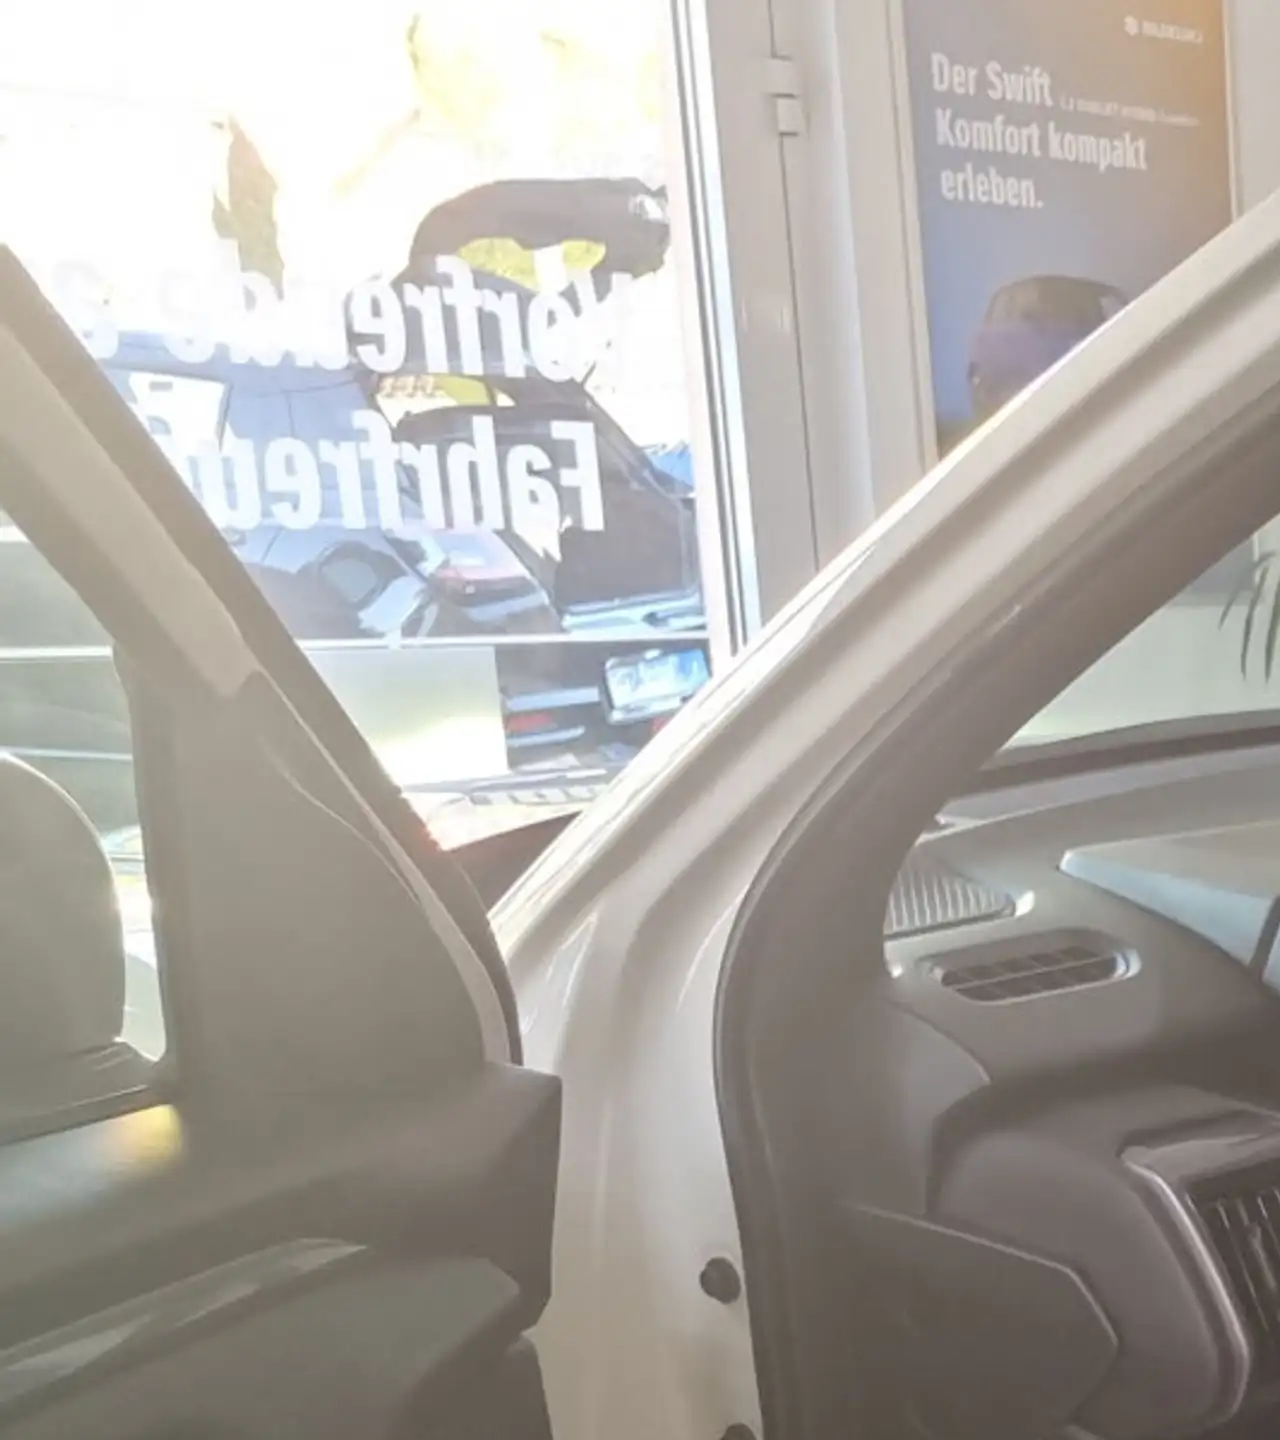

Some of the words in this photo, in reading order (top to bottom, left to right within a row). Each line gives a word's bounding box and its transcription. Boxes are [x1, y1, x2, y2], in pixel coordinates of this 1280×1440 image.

[930, 52, 979, 97] Der
[984, 60, 1055, 107] Swift
[934, 107, 1042, 158] Komfort
[1047, 121, 1148, 173] kompakt
[940, 163, 1044, 209] erleben.
